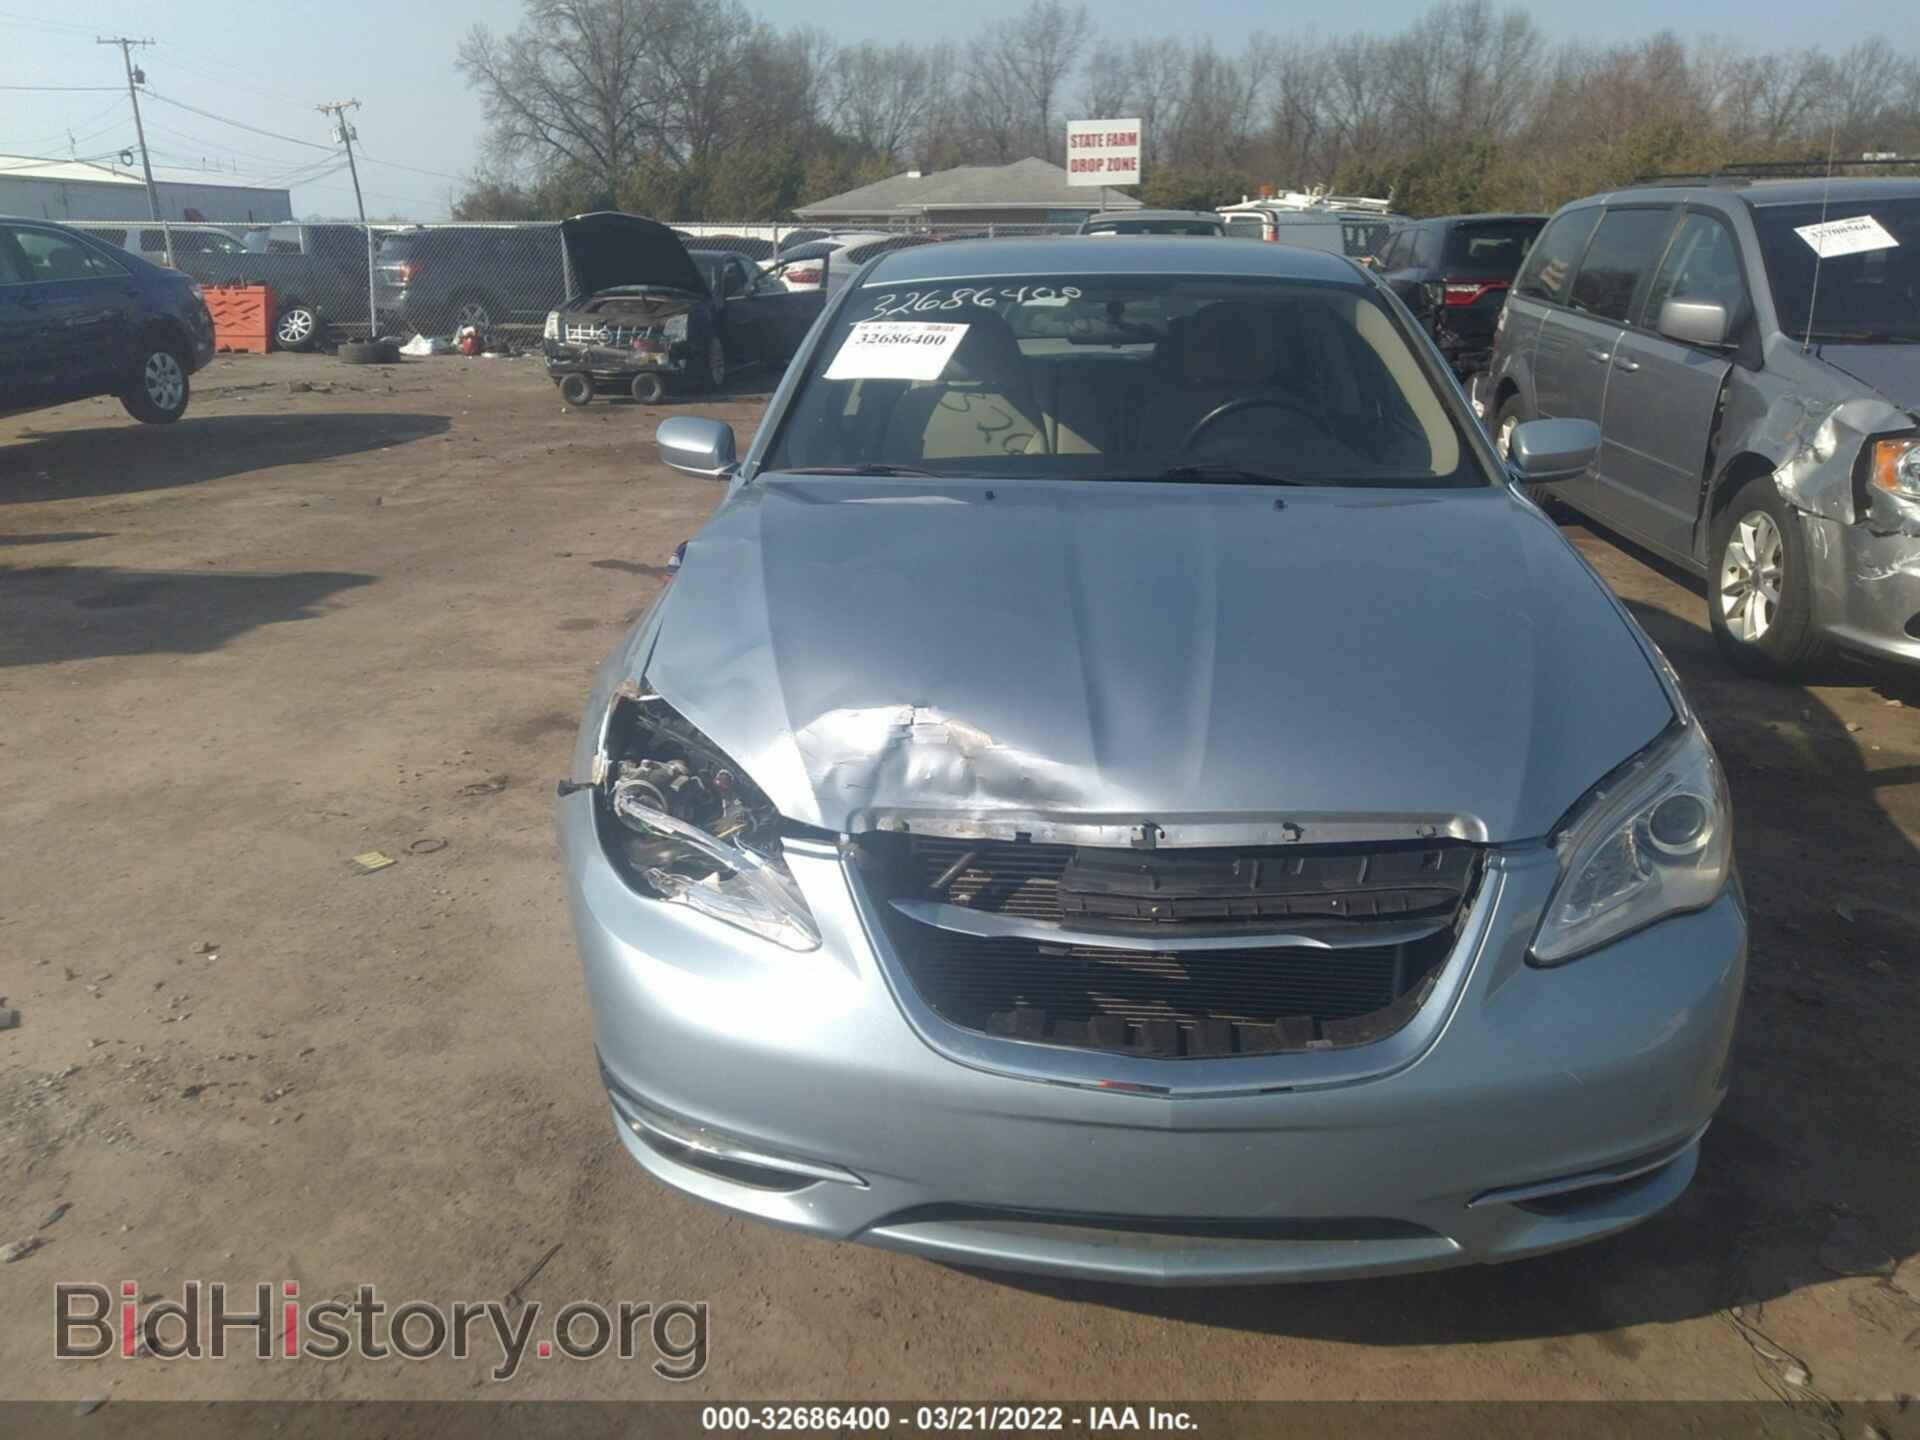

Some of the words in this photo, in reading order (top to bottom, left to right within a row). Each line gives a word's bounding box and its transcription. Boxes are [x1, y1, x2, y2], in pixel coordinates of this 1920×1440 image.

[1071, 133, 1104, 148] STATE
[1106, 132, 1137, 147] FARM
[1071, 158, 1104, 172] DROP
[1106, 157, 1137, 172] ZONE
[855, 332, 947, 346] 32686400
